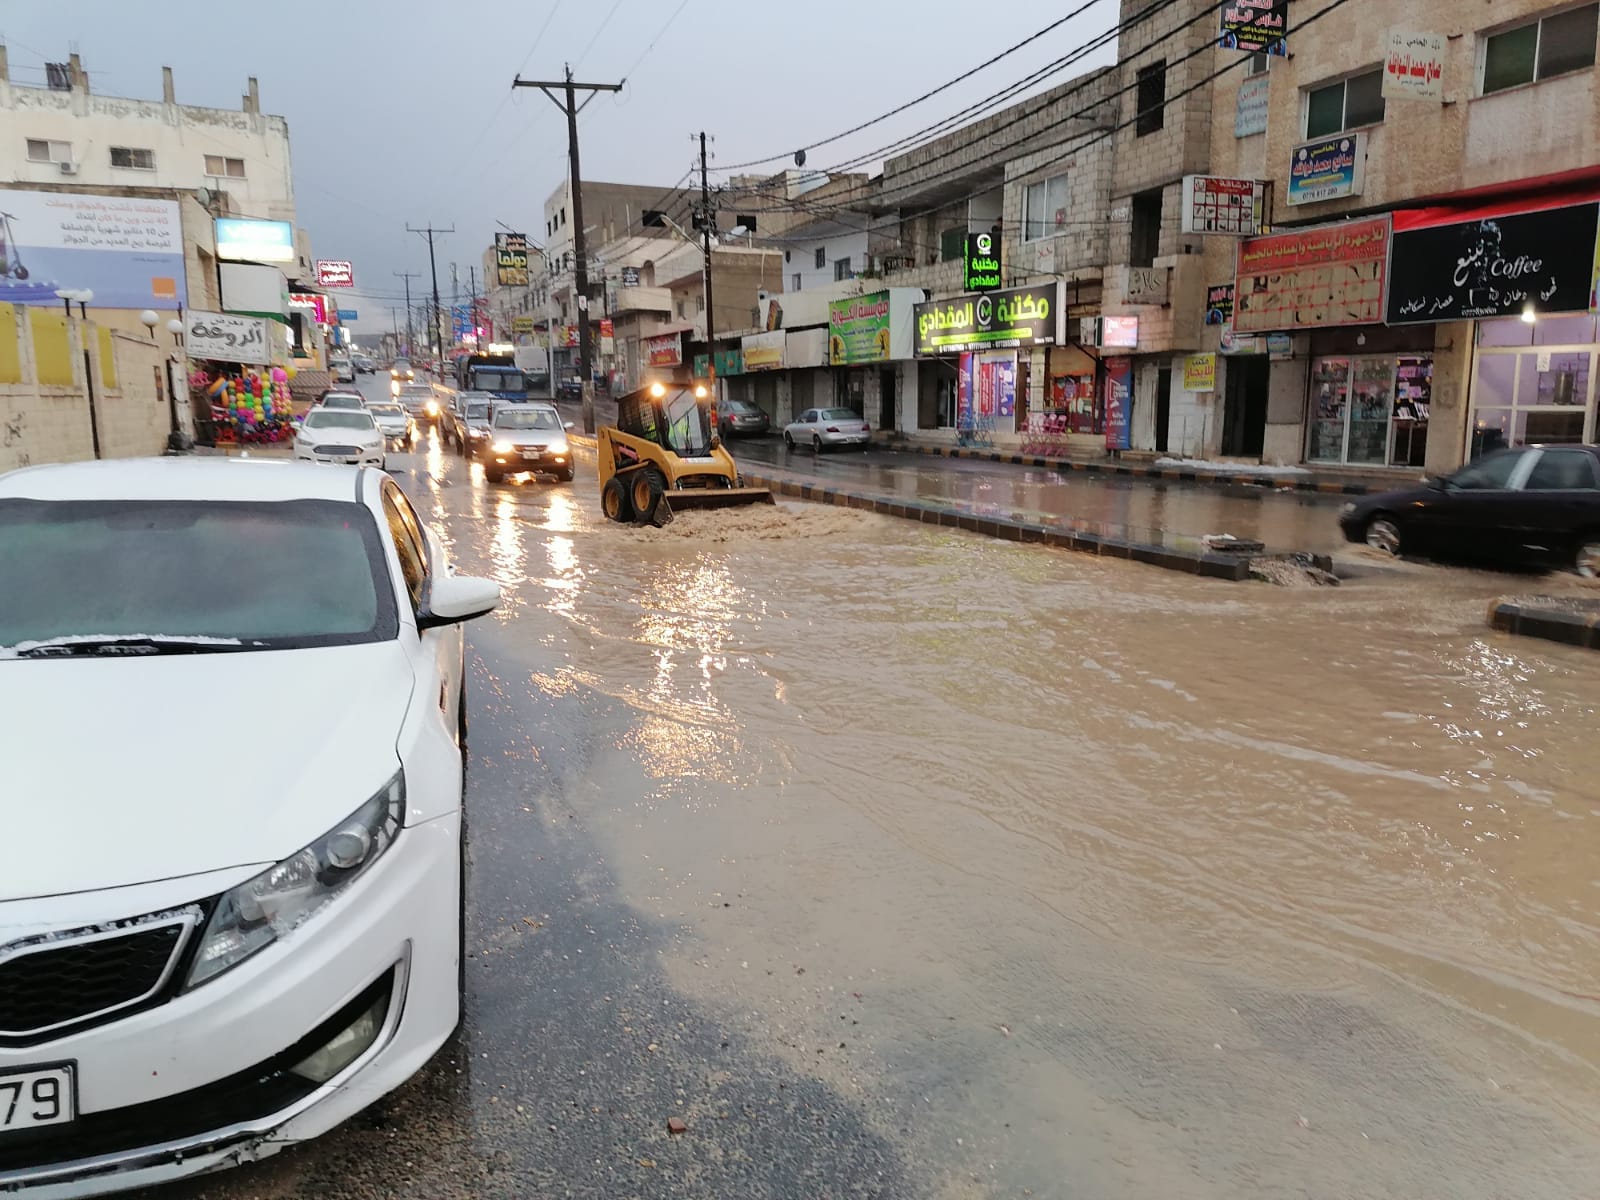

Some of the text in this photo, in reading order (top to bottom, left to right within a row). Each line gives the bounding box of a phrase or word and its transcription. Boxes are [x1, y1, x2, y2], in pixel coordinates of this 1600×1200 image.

[972, 257, 999, 272] مكتبة
[1490, 254, 1543, 280] Coffee
[969, 275, 1000, 290] المقدادي
[918, 302, 974, 340] المقدادي
[997, 293, 1050, 326] مكتبة
[191, 321, 263, 347] الروعة
